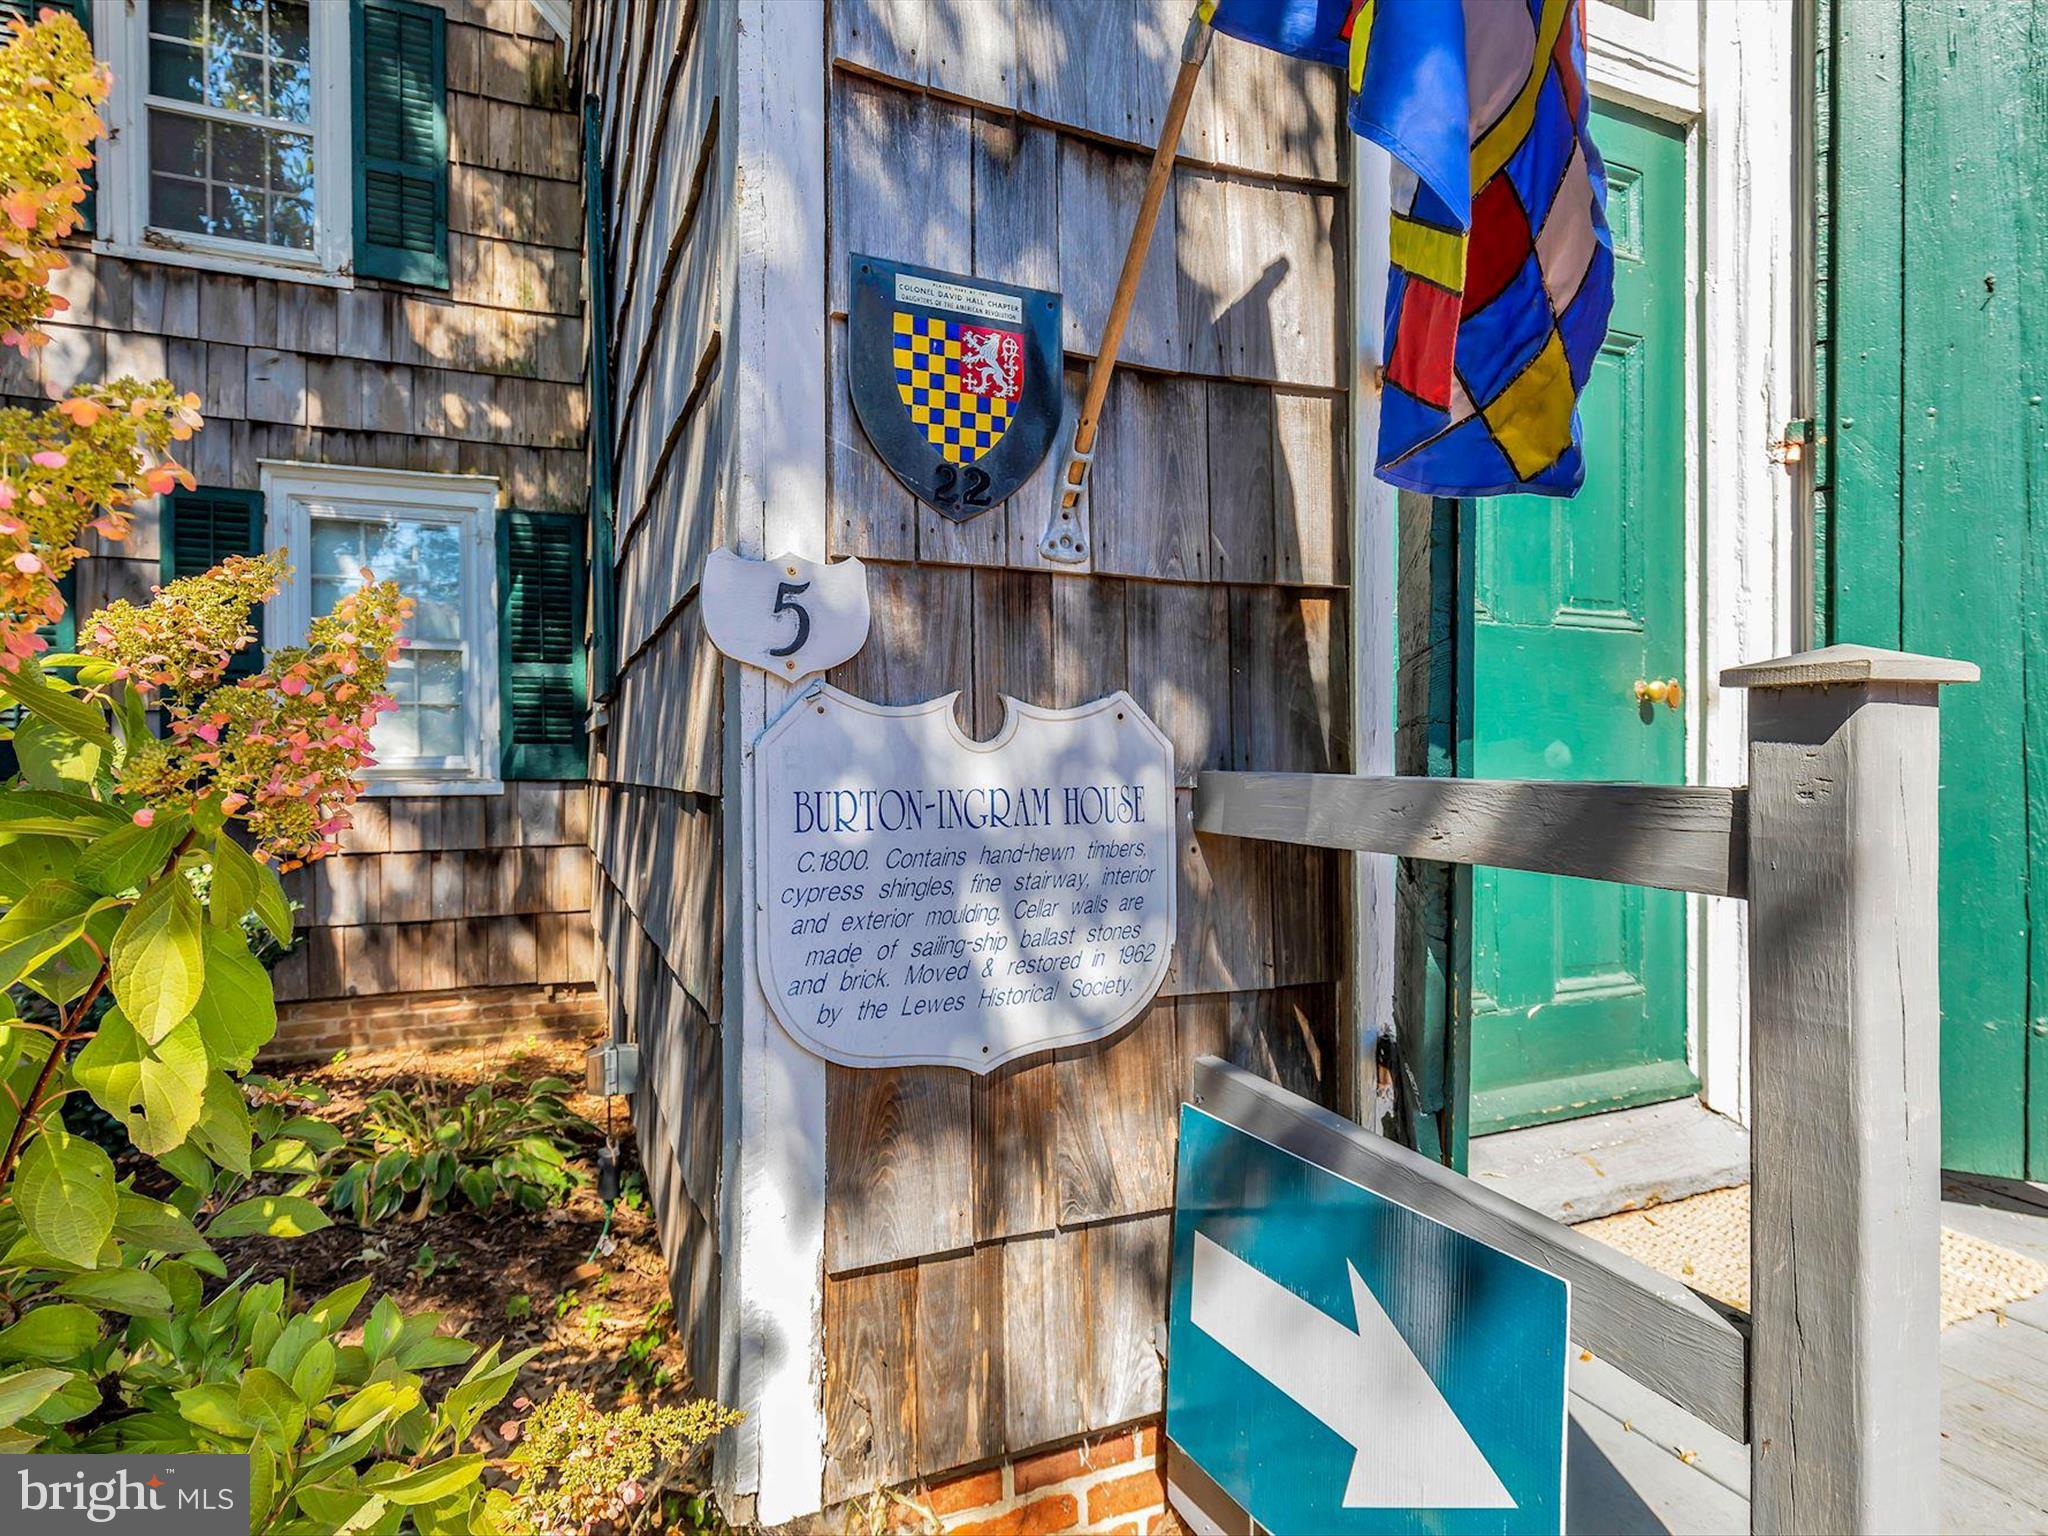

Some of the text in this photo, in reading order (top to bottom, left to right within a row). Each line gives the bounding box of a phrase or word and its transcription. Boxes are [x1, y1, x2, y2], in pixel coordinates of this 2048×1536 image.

[898, 284, 935, 296] COLONEL
[938, 291, 962, 301] DAVID
[966, 297, 983, 305] HALL
[988, 301, 1019, 312] CHAPTER
[901, 294, 932, 304] DAUGHTERS
[956, 304, 983, 314] AMERICAN
[985, 309, 1016, 320] REVOLUTION
[934, 464, 991, 506] 22
[770, 582, 810, 656] 5
[793, 785, 1145, 833] BURTON-INGRAM HOUSE
[886, 847, 967, 869] Contains
[980, 845, 1075, 864] hand-hewn
[781, 866, 1156, 907] cypress shingles, fine stairway, interior
[791, 894, 1144, 936] and exterior moulding. Cellar walls are
[805, 922, 1141, 967] made of sailing-ship ballast stones
[786, 943, 1156, 997] and brick. Moved & restored in 1962
[816, 975, 1134, 1025] by the Lewes Historical Society.
